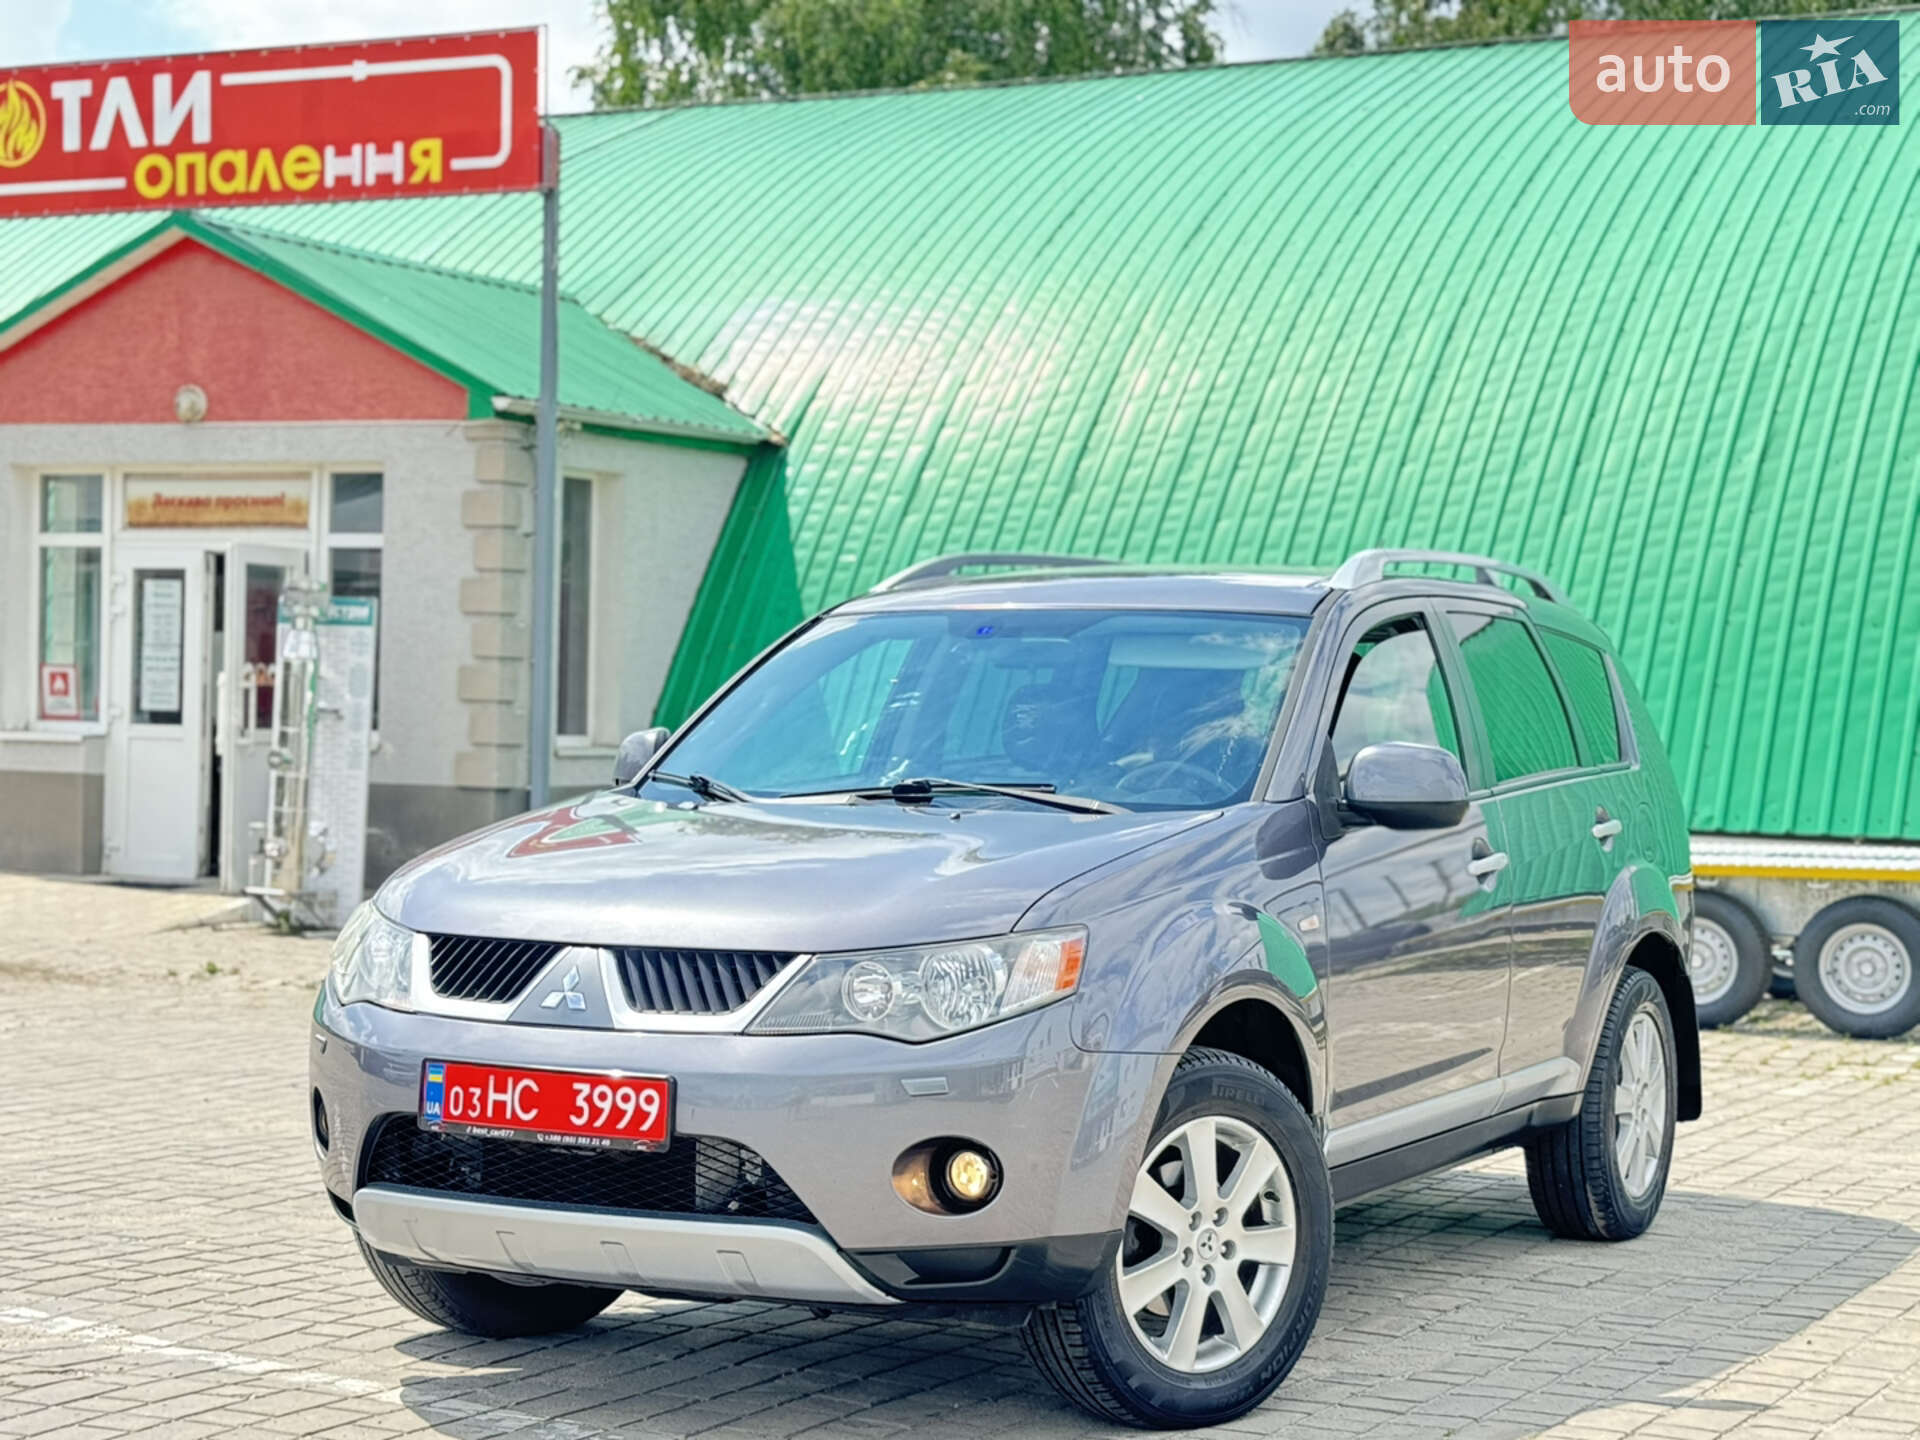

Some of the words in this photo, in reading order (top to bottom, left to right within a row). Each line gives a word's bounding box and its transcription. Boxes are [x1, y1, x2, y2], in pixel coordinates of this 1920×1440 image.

[134, 138, 443, 199] опалення
[425, 1101, 441, 1116] UA
[568, 1082, 661, 1132] 3999
